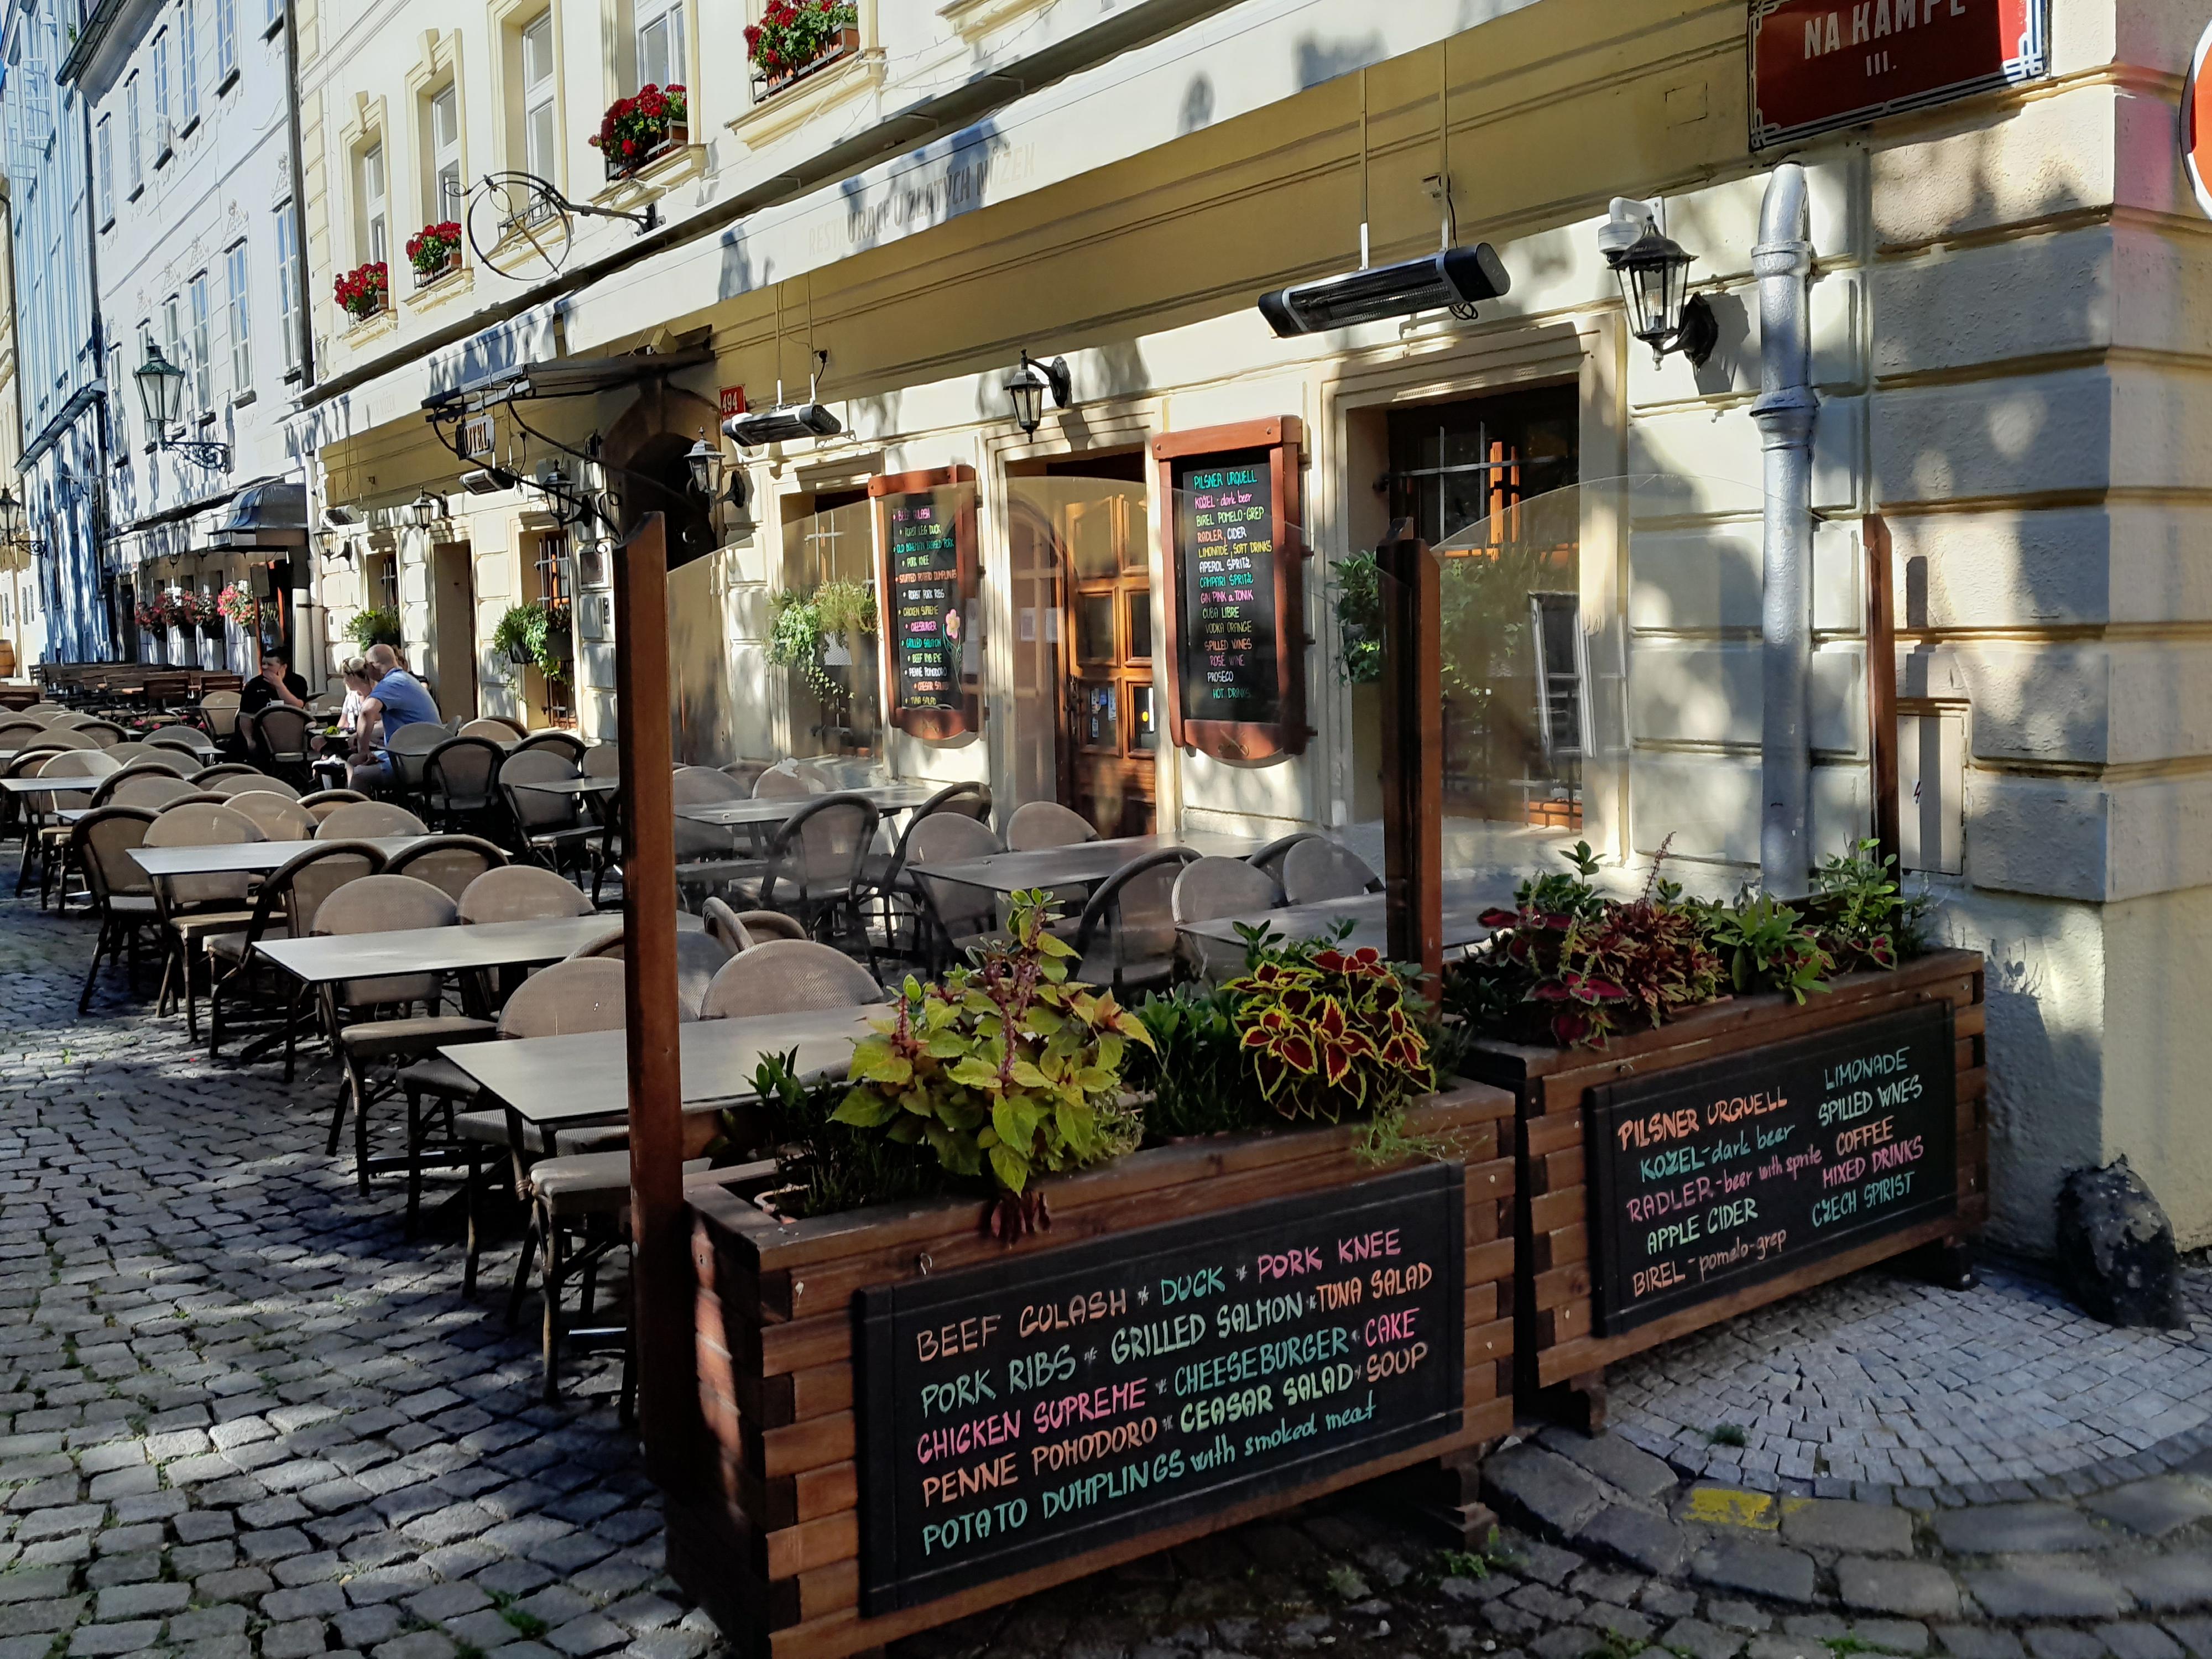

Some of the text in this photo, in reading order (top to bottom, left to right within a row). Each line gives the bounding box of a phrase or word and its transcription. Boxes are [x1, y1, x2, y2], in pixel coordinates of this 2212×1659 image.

[1804, 12, 1841, 60] NA
[1866, 50, 1897, 77] III.
[722, 392, 738, 413] 494
[1194, 470, 1258, 489] PILSNER URQUELL
[1238, 489, 1252, 503] beer
[1196, 514, 1215, 527] BIREL
[1227, 526, 1247, 540] CIDER
[1233, 543, 1248, 554] SOFT
[1250, 540, 1272, 553] DRINKS
[1199, 556, 1251, 573] APEROL SPRITZ
[1199, 572, 1254, 588] CAMPARI SPRITZ
[1201, 592, 1211, 604] GIN
[1212, 591, 1227, 602] PINK
[1234, 589, 1254, 601] TONIK
[1203, 606, 1239, 619] CUBA LIBRE
[1206, 620, 1252, 634] VODKA ORANGE
[1204, 639, 1228, 651] SPILLED
[1229, 654, 1245, 666] WINE
[1207, 670, 1234, 682] PROSECO
[1213, 688, 1224, 698] HOT
[1825, 1046, 1910, 1091] LIMONADE
[1618, 1086, 1787, 1151] PILSNER URQUELL
[1818, 1091, 1874, 1127] SPILLED
[1757, 1124, 1796, 1151] beer
[1836, 1115, 1895, 1156] COFFEE
[1759, 1154, 1783, 1181] with
[1786, 1144, 1823, 1181] sprite
[1822, 1135, 1924, 1190] MIXED DRINKS
[1812, 1171, 1915, 1228] CZECH SPIRIST
[1646, 1198, 1759, 1255] APPLE CIDER
[1632, 1260, 1686, 1298] BIREL
[916, 1228, 1402, 1363] BEEF GULASH DUCK PORK KNEE
[921, 1261, 1433, 1418] PORK RIBS GRILLED SALMON TUNA SALAD
[916, 1307, 1420, 1465] CHICKEN SUPREME CHEESEBURGER CAKE
[922, 1341, 1429, 1508] PENNE POMODORO CEASAR SALAD SOUP
[922, 1389, 1378, 1557] POTATO DUMPLINGS with smoked meat
